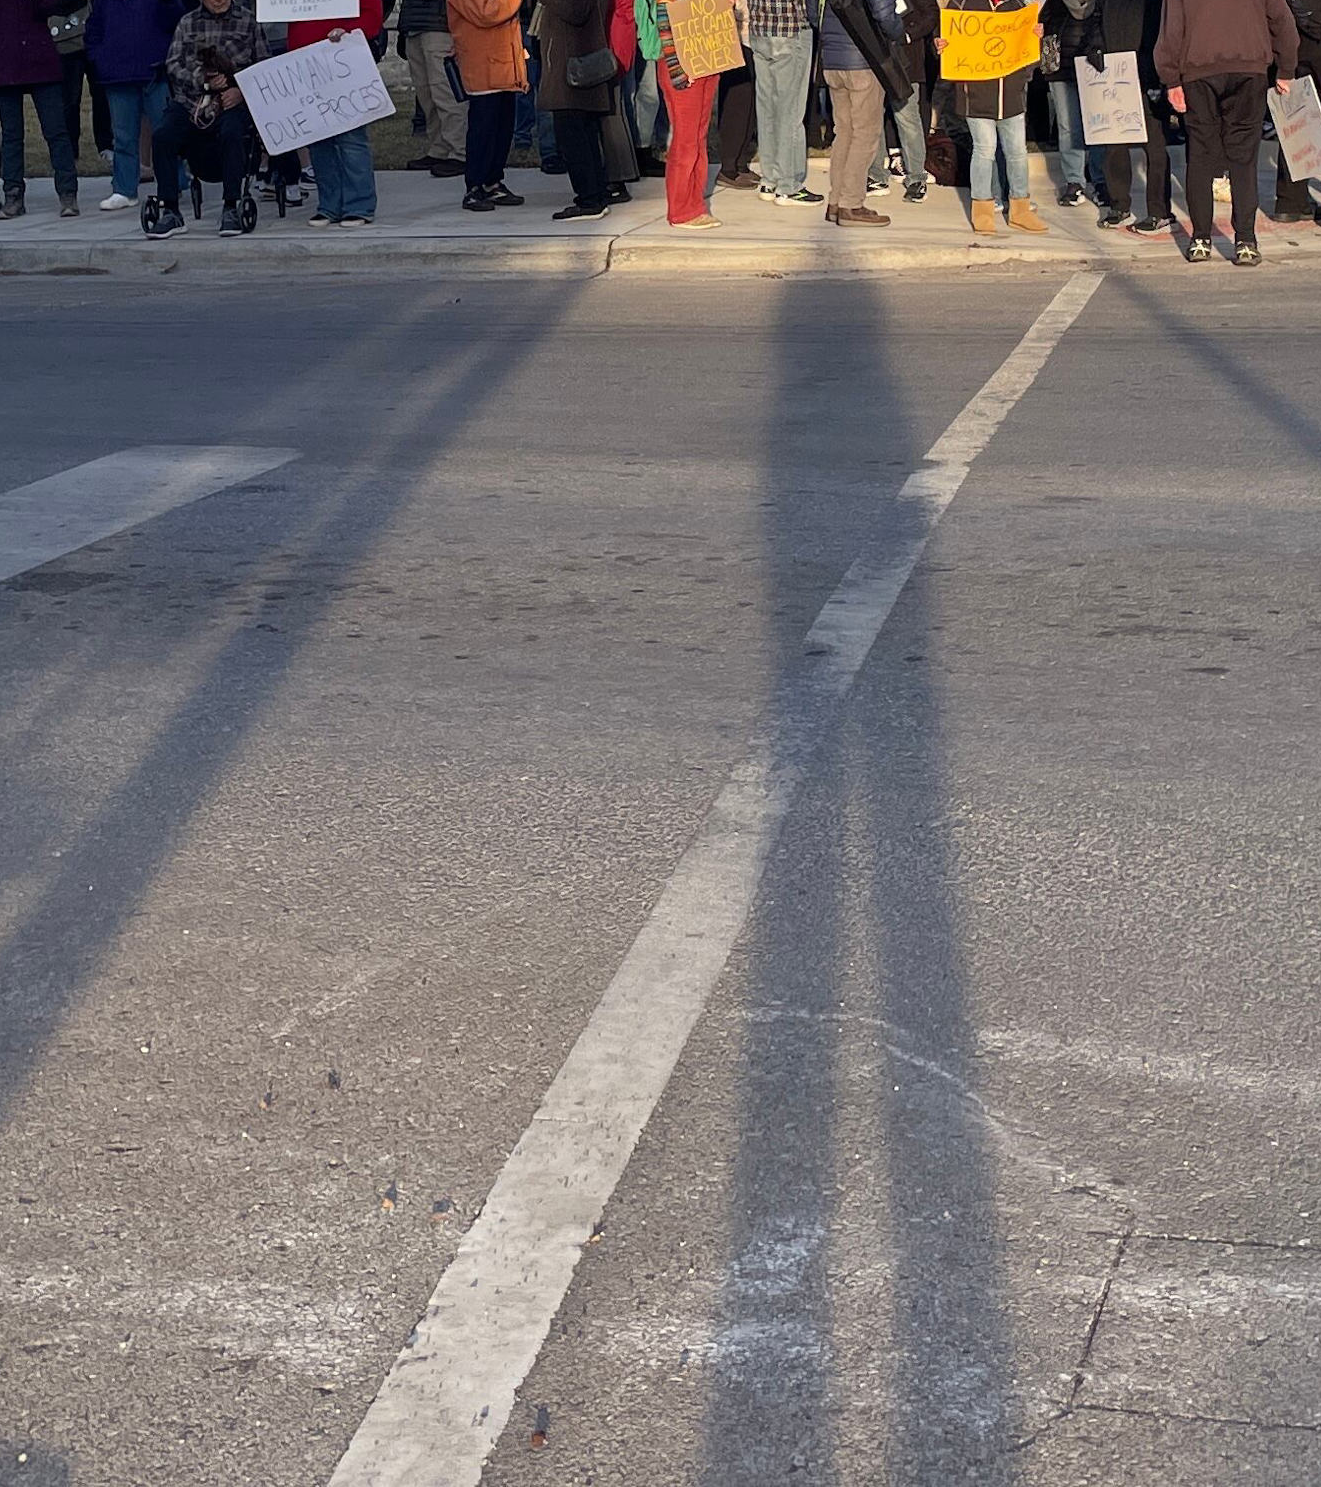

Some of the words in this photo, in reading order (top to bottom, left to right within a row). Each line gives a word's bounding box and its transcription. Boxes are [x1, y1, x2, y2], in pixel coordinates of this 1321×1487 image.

[673, 17, 700, 41] ICE
[949, 13, 981, 37] NO
[690, 47, 737, 75] EVER
[254, 49, 352, 106] HUMANS
[299, 91, 325, 105] FOR
[265, 110, 313, 147] DUE
[317, 79, 389, 127] PROCESS
